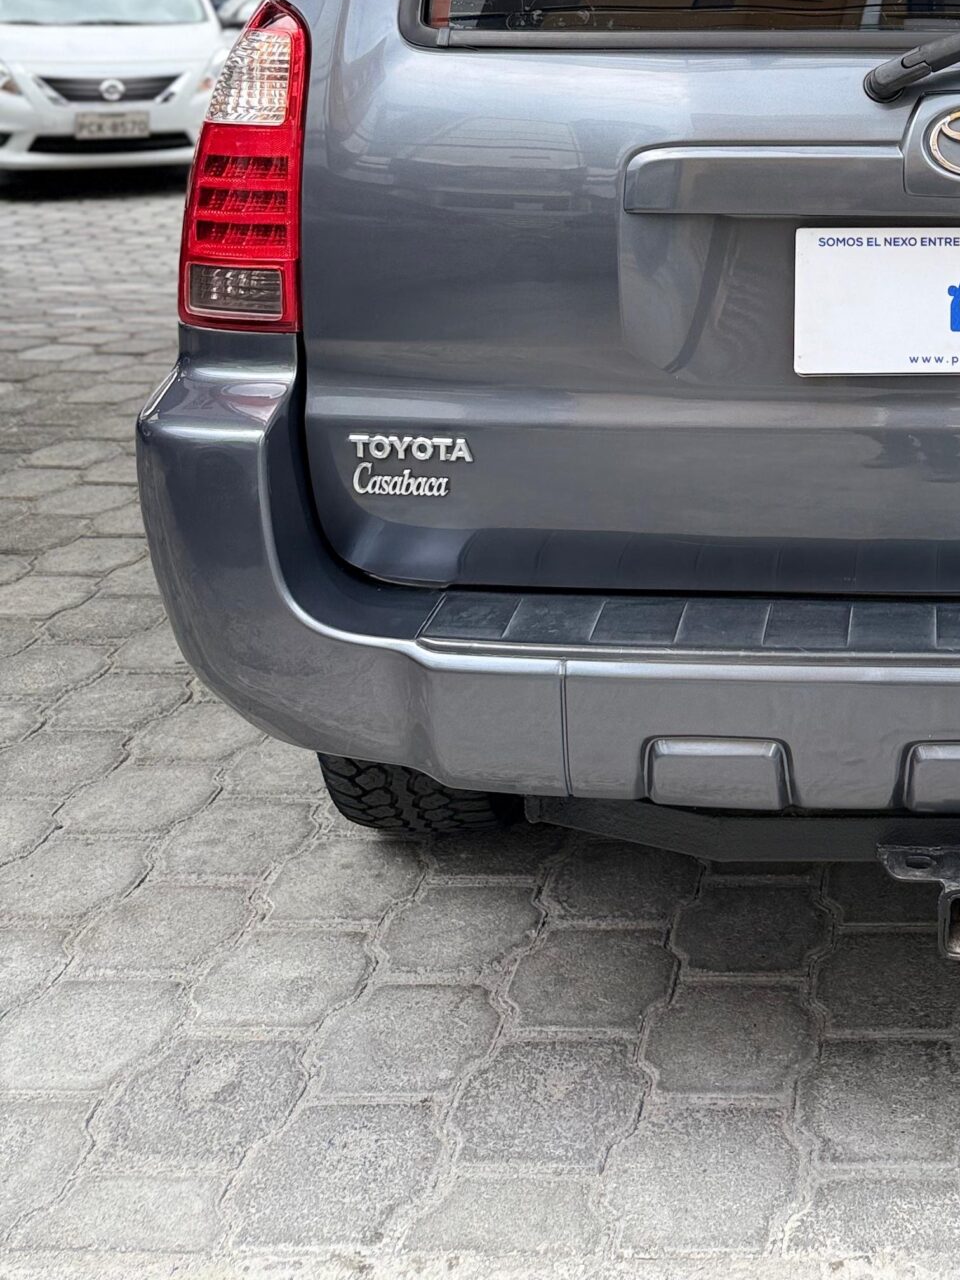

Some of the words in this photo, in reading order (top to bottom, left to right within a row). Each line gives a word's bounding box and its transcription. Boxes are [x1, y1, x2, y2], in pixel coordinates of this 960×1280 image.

[818, 236, 864, 247] SOMOS
[866, 236, 881, 247] EL
[883, 236, 918, 247] NEXO
[920, 236, 960, 247] ENTRE
[348, 434, 473, 462] TOYOTA
[352, 461, 449, 497] Casabaca
